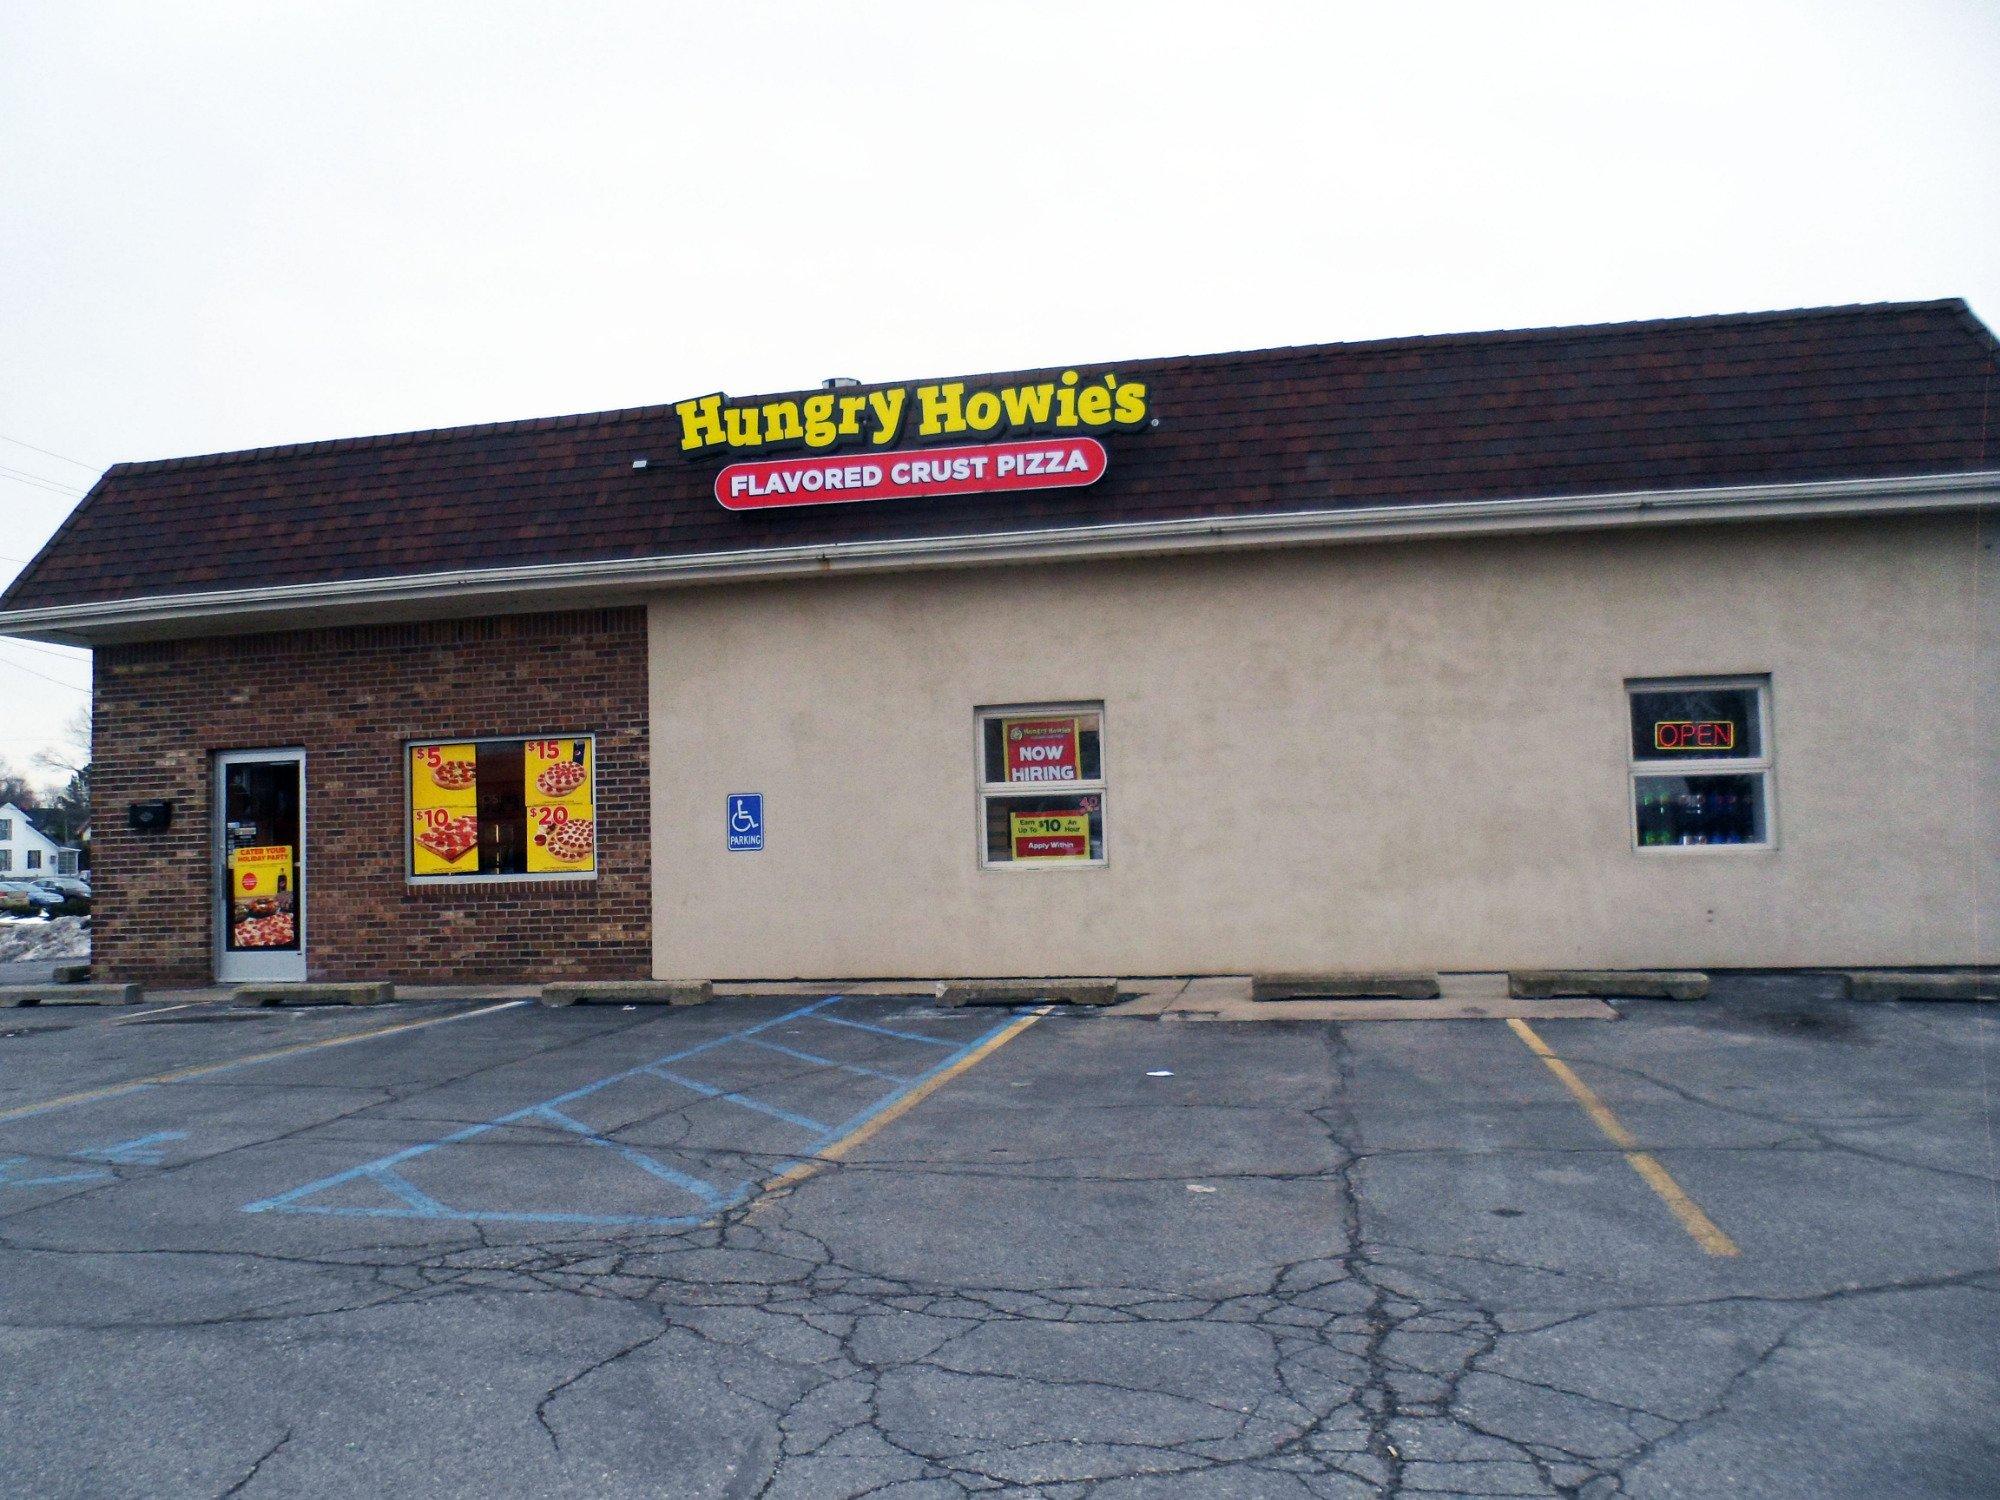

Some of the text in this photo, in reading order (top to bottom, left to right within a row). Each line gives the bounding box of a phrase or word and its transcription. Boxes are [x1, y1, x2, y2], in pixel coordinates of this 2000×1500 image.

[676, 370, 1146, 450] Hungry Howie's
[731, 449, 1088, 497] FLAVORED CRUST PIZZA
[1659, 723, 1731, 747] OPEN
[417, 747, 442, 768] $5
[528, 740, 560, 759] $15
[1020, 745, 1064, 761] NOW
[1011, 765, 1075, 781] HIRING
[416, 808, 449, 828] $10
[530, 805, 568, 825] $20
[1038, 818, 1061, 832] $10
[730, 835, 761, 845] PARKING
[1028, 841, 1074, 850] Apply Within
[240, 848, 264, 856] CATER
[266, 853, 289, 861] PARTY
